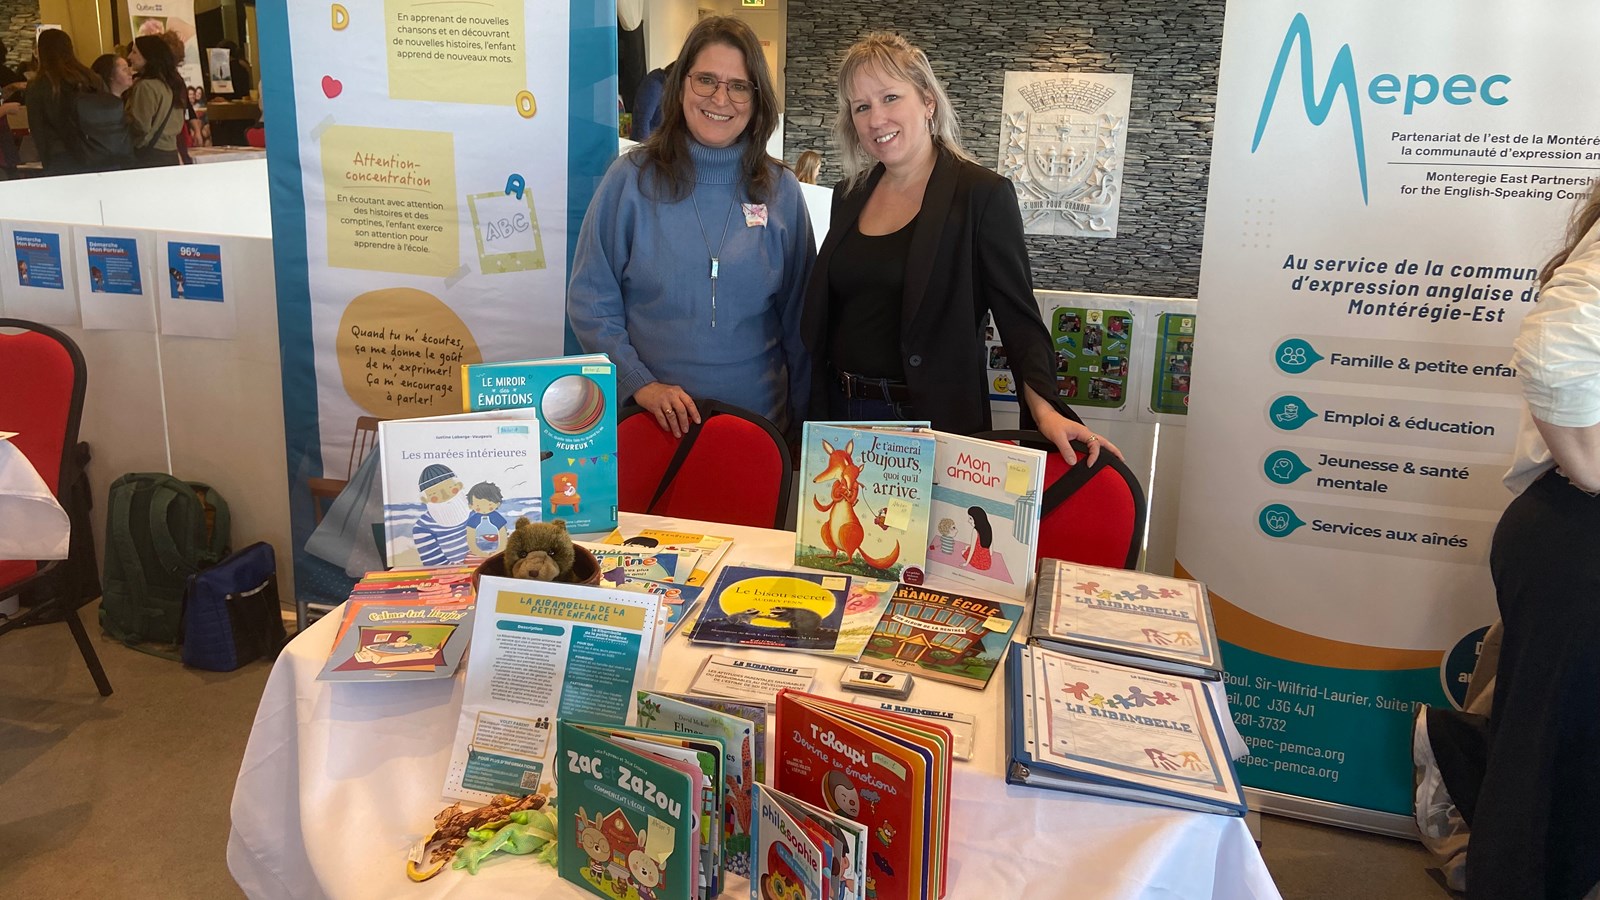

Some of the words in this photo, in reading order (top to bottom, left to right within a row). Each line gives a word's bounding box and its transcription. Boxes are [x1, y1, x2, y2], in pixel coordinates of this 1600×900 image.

[398, 13, 409, 22] En
[410, 14, 454, 26] apprenant
[456, 15, 467, 24] de
[469, 16, 509, 26] nouvelles
[398, 25, 436, 36] chansons
[439, 27, 447, 35] et
[462, 27, 509, 38] découvrant
[393, 37, 403, 46] de
[405, 38, 444, 48] nouvelles
[446, 39, 483, 50] histoires,
[485, 41, 516, 50] l'enfant
[397, 50, 432, 61] apprend
[434, 51, 445, 60] de
[447, 53, 487, 61] nouveaux
[489, 54, 513, 63] mots.
[1251, 12, 1512, 206] Mepec
[1391, 132, 1461, 142] Partenariat
[1464, 131, 1480, 142] de
[1483, 132, 1510, 143] l'est
[1513, 134, 1529, 144] de
[1532, 134, 1543, 144] la
[353, 152, 421, 169] Attention-
[1401, 146, 1412, 156] la
[1414, 146, 1497, 158] communauté
[1500, 147, 1582, 160] d'expression
[345, 171, 431, 187] concentration
[1426, 171, 1497, 185] Monteregie
[1501, 173, 1528, 184] East
[1400, 184, 1418, 195] for
[1421, 184, 1440, 196] the
[1444, 186, 1553, 201] English-Speaking
[350, 195, 385, 206] écoutant
[387, 199, 405, 207] avec
[407, 201, 443, 210] attention
[1046, 201, 1062, 209] POUR
[1064, 202, 1090, 212] GRANDIR
[354, 207, 368, 215] des
[370, 208, 403, 217] histoires
[341, 217, 384, 228] comptines,
[386, 220, 415, 230] l'enfant
[417, 224, 443, 232] exerce
[486, 213, 529, 241] ABC
[371, 230, 408, 240] attention
[410, 234, 428, 243] pour
[180, 246, 201, 257] 96%
[354, 240, 395, 251] apprendre
[397, 242, 402, 250] à
[404, 243, 430, 253] l'école.
[1283, 254, 1308, 270] Au
[1314, 257, 1388, 274] service
[1395, 259, 1418, 276] de
[1425, 260, 1444, 277] la
[1292, 276, 1419, 296] d'expression
[1426, 284, 1513, 303] anglaise
[1348, 300, 1505, 322] Montérégie-Est
[352, 325, 384, 340] Quand
[390, 329, 400, 340] tu
[355, 345, 365, 354] ça
[371, 346, 386, 354] me
[391, 344, 421, 358] donne
[426, 348, 435, 359] le
[440, 352, 463, 366] goût
[366, 358, 377, 369] de
[1330, 353, 1394, 369] Famille
[1398, 358, 1411, 370] &
[1415, 358, 1468, 374] petite
[367, 373, 379, 387] Ça
[482, 378, 493, 387] LE
[496, 377, 526, 387] MIROIR
[387, 392, 392, 401] à
[397, 393, 433, 406] parler!
[478, 392, 533, 406] ÉMOTIONS
[1324, 410, 1384, 428] Emploi
[1388, 416, 1400, 428] &
[1405, 417, 1495, 436] éducation
[556, 441, 588, 450] HEUREUX
[871, 436, 882, 454] Je
[883, 441, 921, 456] t'aimerai
[402, 450, 421, 460] Les
[423, 448, 464, 459] marées
[466, 449, 527, 458] intérieures
[861, 450, 922, 475] toujours,
[957, 453, 990, 473] Mon
[1319, 454, 1399, 473] Jeunesse
[1403, 462, 1416, 475] &
[1420, 464, 1469, 480] santé
[883, 471, 899, 482] quoi
[902, 473, 918, 484] qu'il
[947, 465, 1000, 488] amour
[1317, 477, 1388, 493] mentale
[1312, 519, 1382, 538] Services
[1386, 530, 1417, 542] aux
[1422, 532, 1468, 548] aînés
[736, 586, 750, 595] Le
[754, 588, 787, 599] bisou
[792, 593, 827, 601] secret
[520, 597, 531, 605] LA
[535, 599, 595, 612] RIBAMBELLE
[599, 605, 610, 613] DE
[613, 608, 625, 616] LA
[531, 606, 563, 617] PETITE
[567, 610, 609, 621] ENFANCE
[952, 597, 1000, 616] ÉCOLE
[1075, 596, 1092, 604] LA
[1097, 599, 1189, 619] RIBAMBELLE
[1223, 671, 1251, 687] Boul.
[1255, 676, 1371, 708] Sir-Wilfrid-Laurier,
[1376, 695, 1409, 712] Suite
[1245, 695, 1260, 709] QC
[1267, 699, 1291, 713] J3G
[1294, 704, 1315, 717] 4J1
[1066, 703, 1086, 714] LA
[1090, 707, 1192, 733] RIBAMBELLE
[793, 730, 828, 763] Devine
[845, 765, 897, 795] émotions
